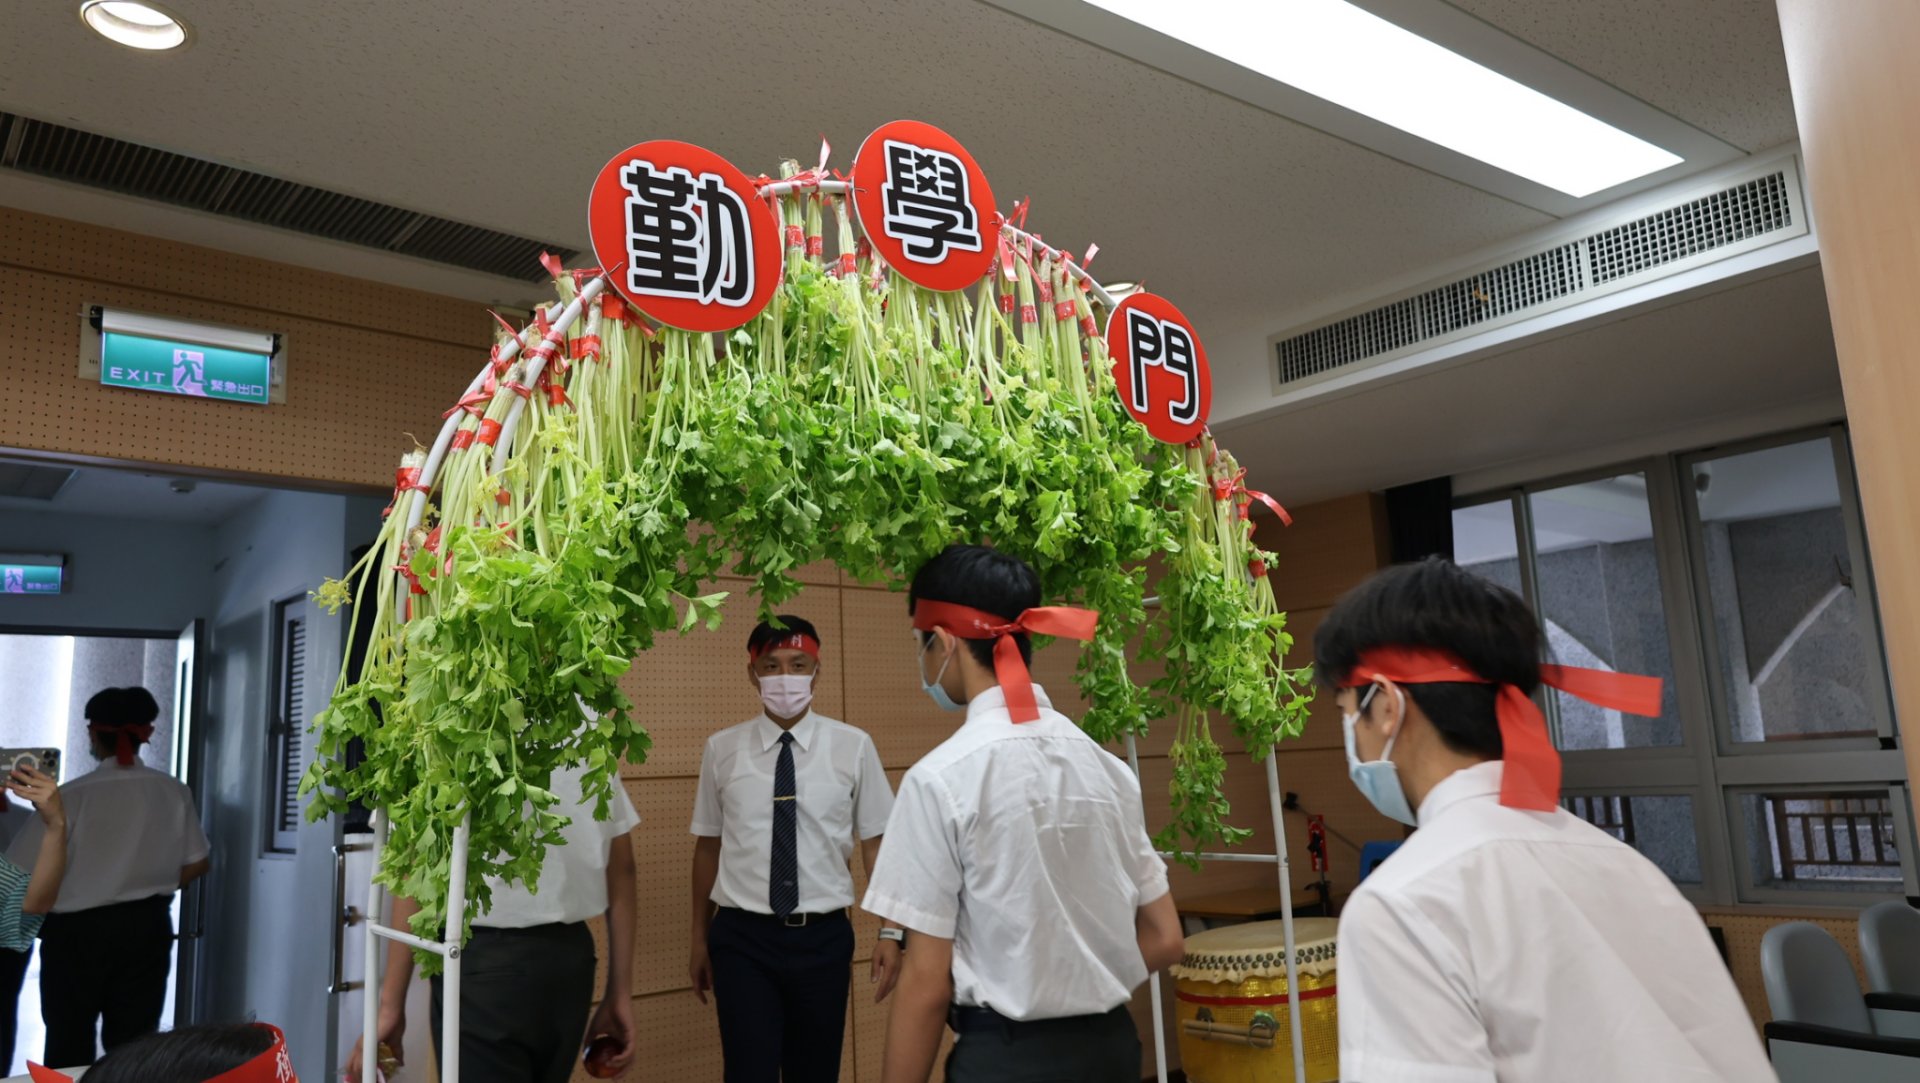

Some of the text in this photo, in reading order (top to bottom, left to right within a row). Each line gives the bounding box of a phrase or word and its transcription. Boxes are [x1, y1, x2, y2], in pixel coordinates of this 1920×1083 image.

[621, 140, 1199, 424] 勤 學 門
[110, 366, 165, 385] EXIT
[210, 379, 264, 397] 緊急出口
